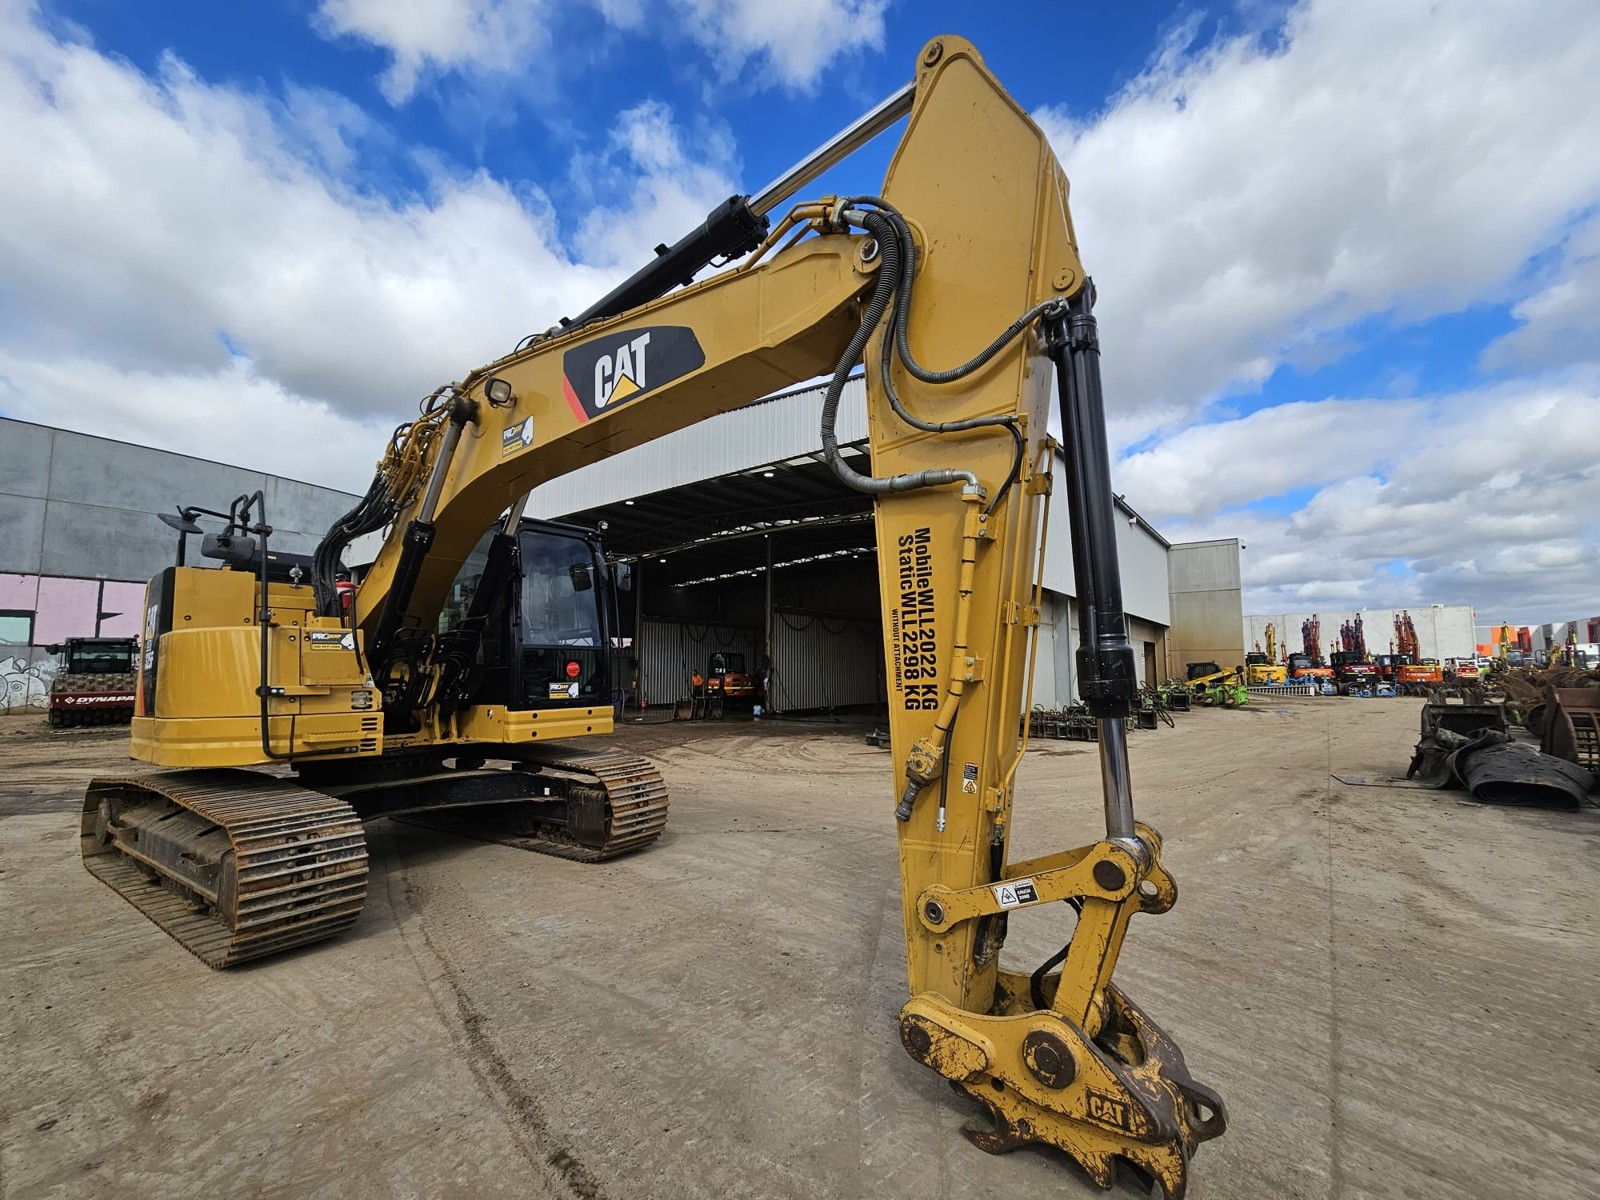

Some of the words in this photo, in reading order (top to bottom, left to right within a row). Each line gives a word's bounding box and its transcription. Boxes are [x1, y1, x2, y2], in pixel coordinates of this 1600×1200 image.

[595, 332, 650, 408] CAT
[891, 608, 900, 642] WITHOUT
[893, 643, 903, 693] ATTACHMENT
[76, 695, 135, 704] DYNAPA
[904, 684, 921, 711] KG
[921, 684, 939, 711] KG
[1090, 1096, 1124, 1126] CAT
